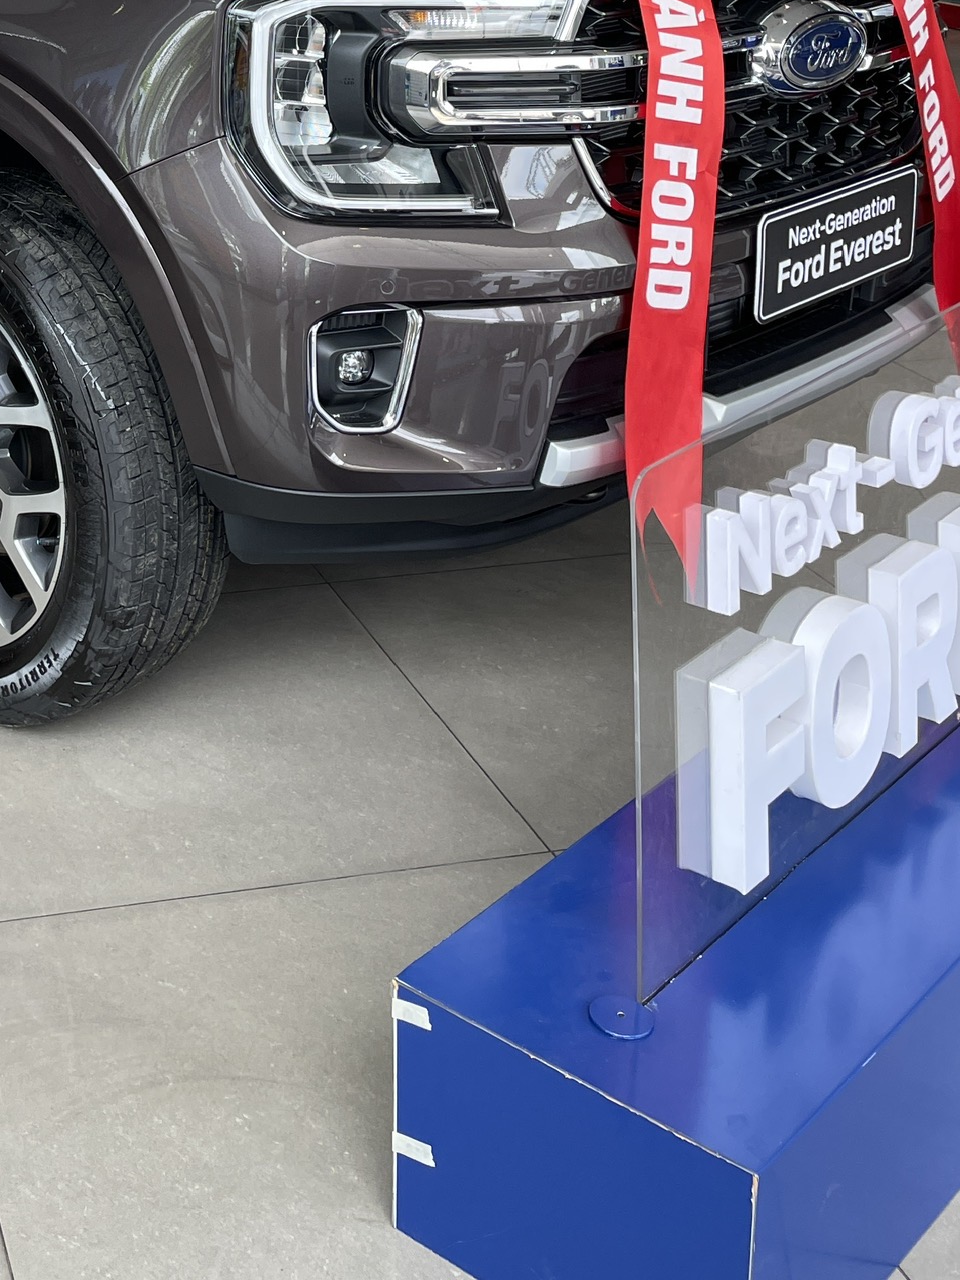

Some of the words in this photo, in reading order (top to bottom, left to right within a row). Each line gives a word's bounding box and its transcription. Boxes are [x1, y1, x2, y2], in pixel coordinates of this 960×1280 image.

[807, 30, 852, 73] Ford
[918, 58, 956, 202] FORD
[646, 142, 699, 310] FORD
[777, 244, 826, 294] Ford
[829, 217, 903, 273] Everest
[788, 195, 896, 249] Next-Generation
